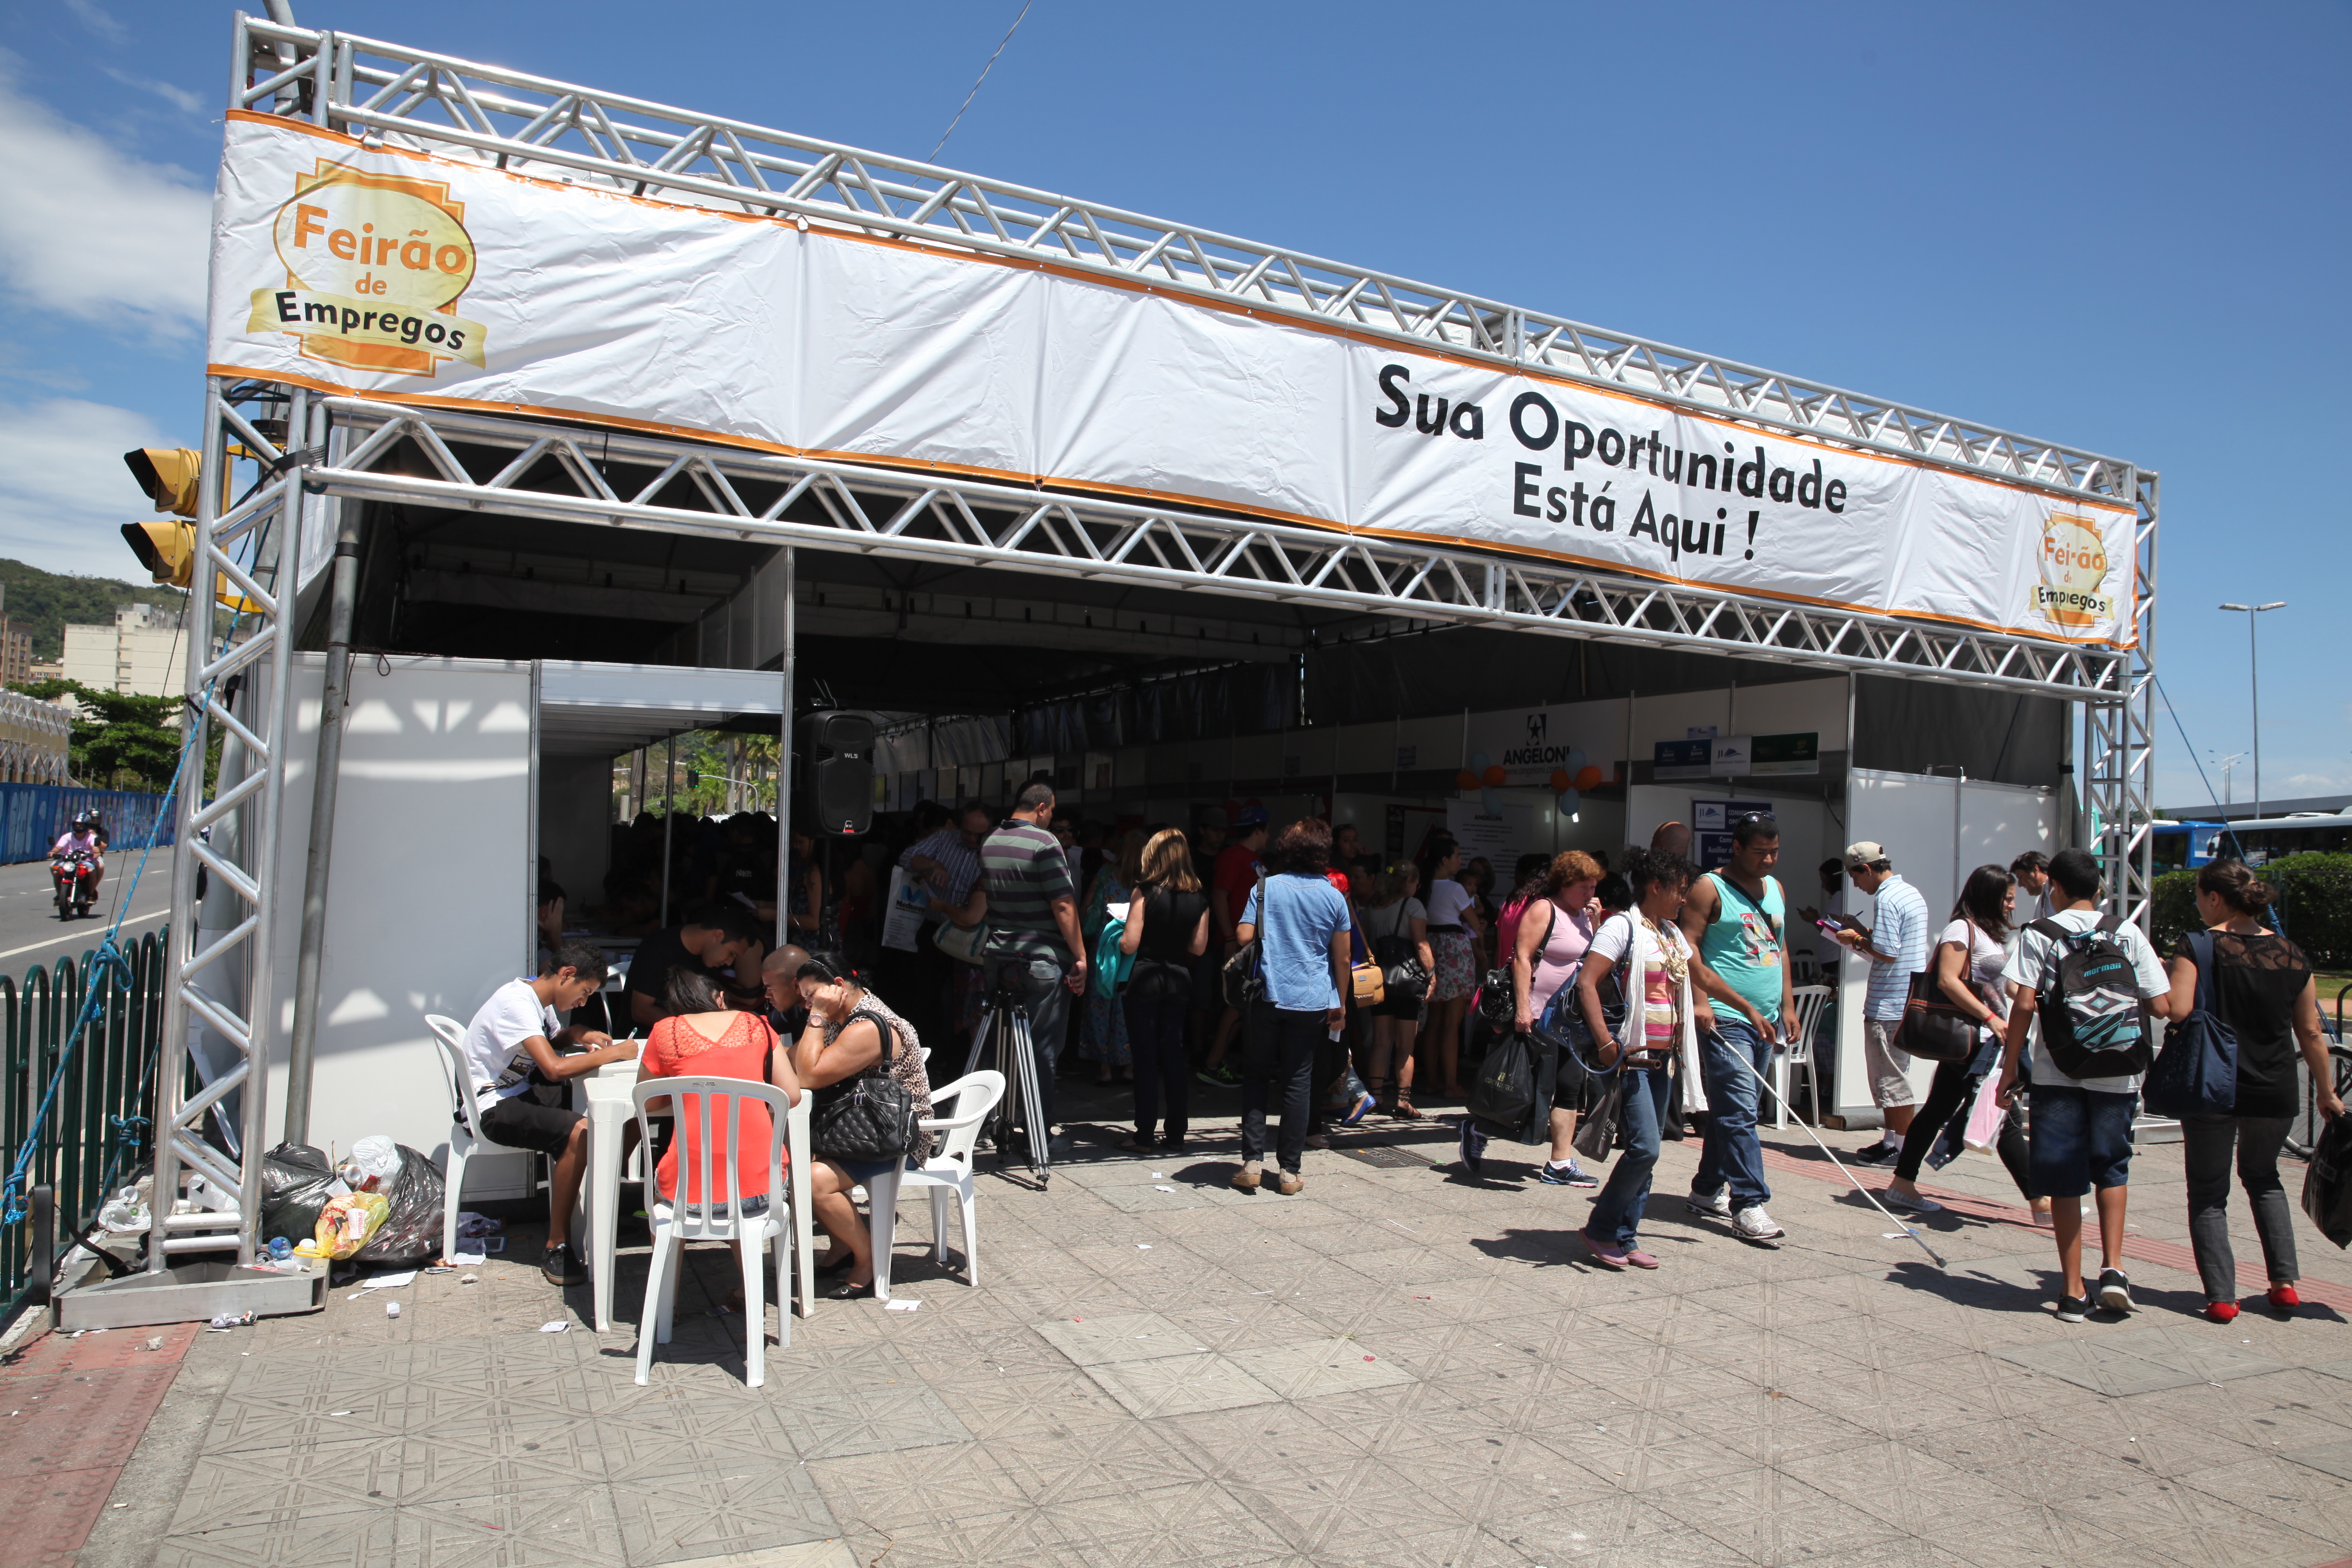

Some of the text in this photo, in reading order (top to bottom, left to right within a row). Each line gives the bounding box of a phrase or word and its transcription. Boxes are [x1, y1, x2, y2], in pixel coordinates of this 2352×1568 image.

[294, 203, 468, 274] Feirão
[355, 272, 387, 295] de
[276, 291, 466, 350] Empregos
[1375, 364, 1847, 514] Sua Oportunidade
[1513, 461, 1615, 533] Está
[1628, 488, 1725, 562] Aqui
[736, 869, 752, 877] NIKE
[2083, 962, 2122, 977] mormaii
